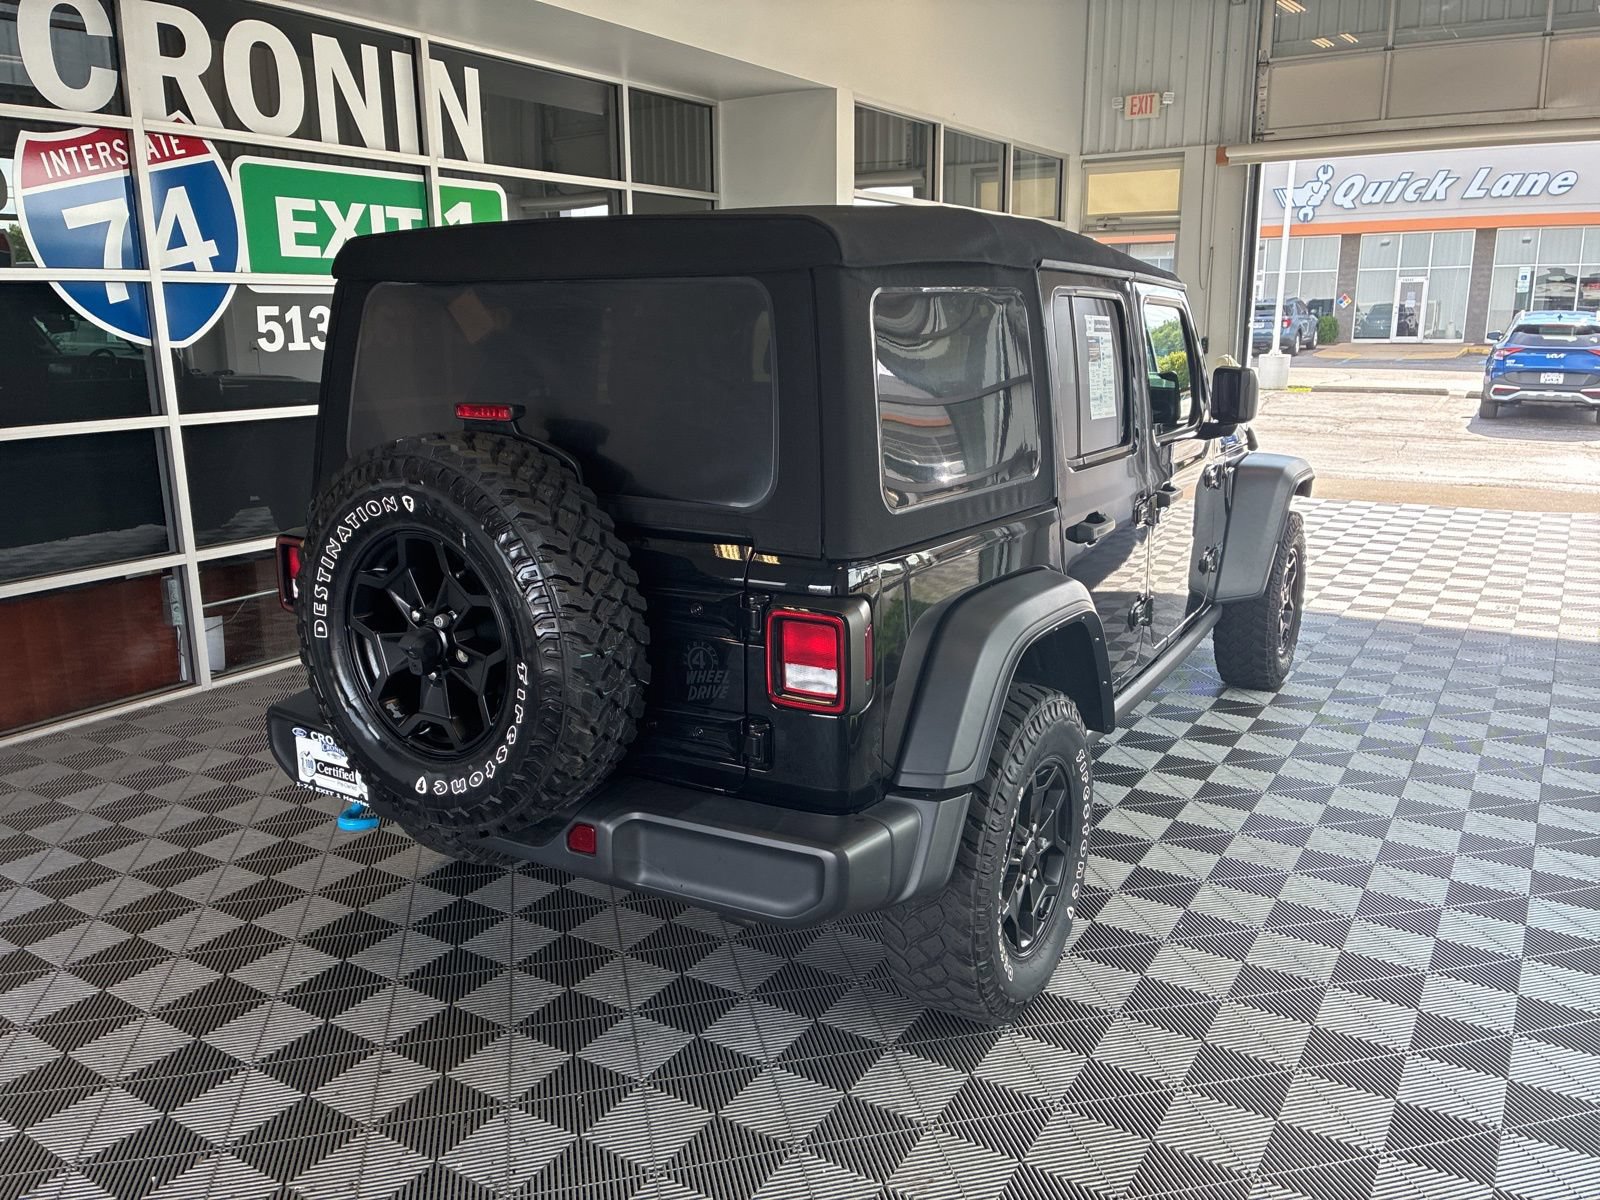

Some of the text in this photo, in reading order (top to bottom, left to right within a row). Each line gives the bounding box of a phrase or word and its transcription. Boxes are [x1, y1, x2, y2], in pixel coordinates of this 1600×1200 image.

[17, 0, 485, 164] CRONIN
[1130, 94, 1155, 116] EXIT
[40, 134, 186, 179] INTERSATE
[1333, 166, 1579, 210] Quick Lane
[61, 186, 220, 304] 74
[313, 495, 399, 639] DESTINATION
[686, 670, 730, 685] WHEEL
[687, 685, 729, 702] DRIVE
[316, 761, 355, 782] Certified
[296, 781, 314, 790] I-74
[315, 787, 335, 797] EXIT
